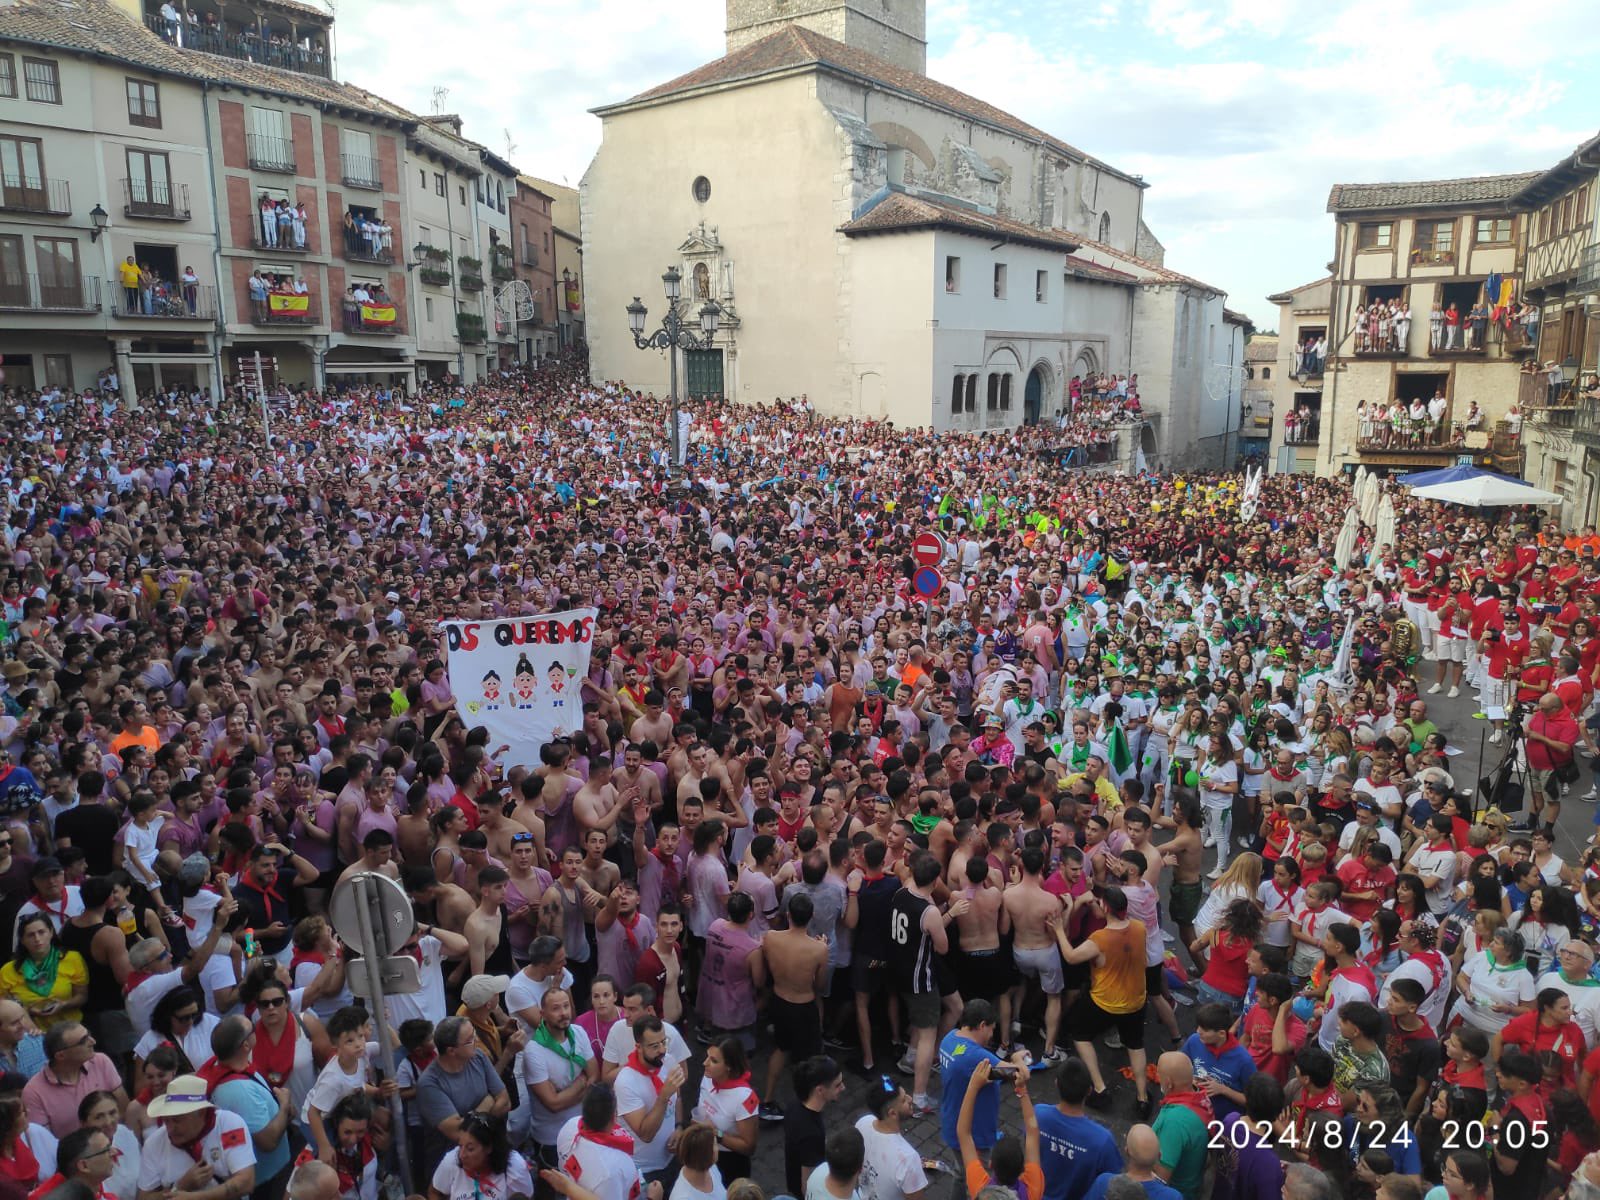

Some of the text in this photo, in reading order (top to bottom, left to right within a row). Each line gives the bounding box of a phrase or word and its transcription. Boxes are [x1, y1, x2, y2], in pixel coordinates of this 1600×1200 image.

[446, 616, 593, 651] OS QUEREMOS
[891, 908, 909, 945] 16
[1050, 1141, 1075, 1160] DYC
